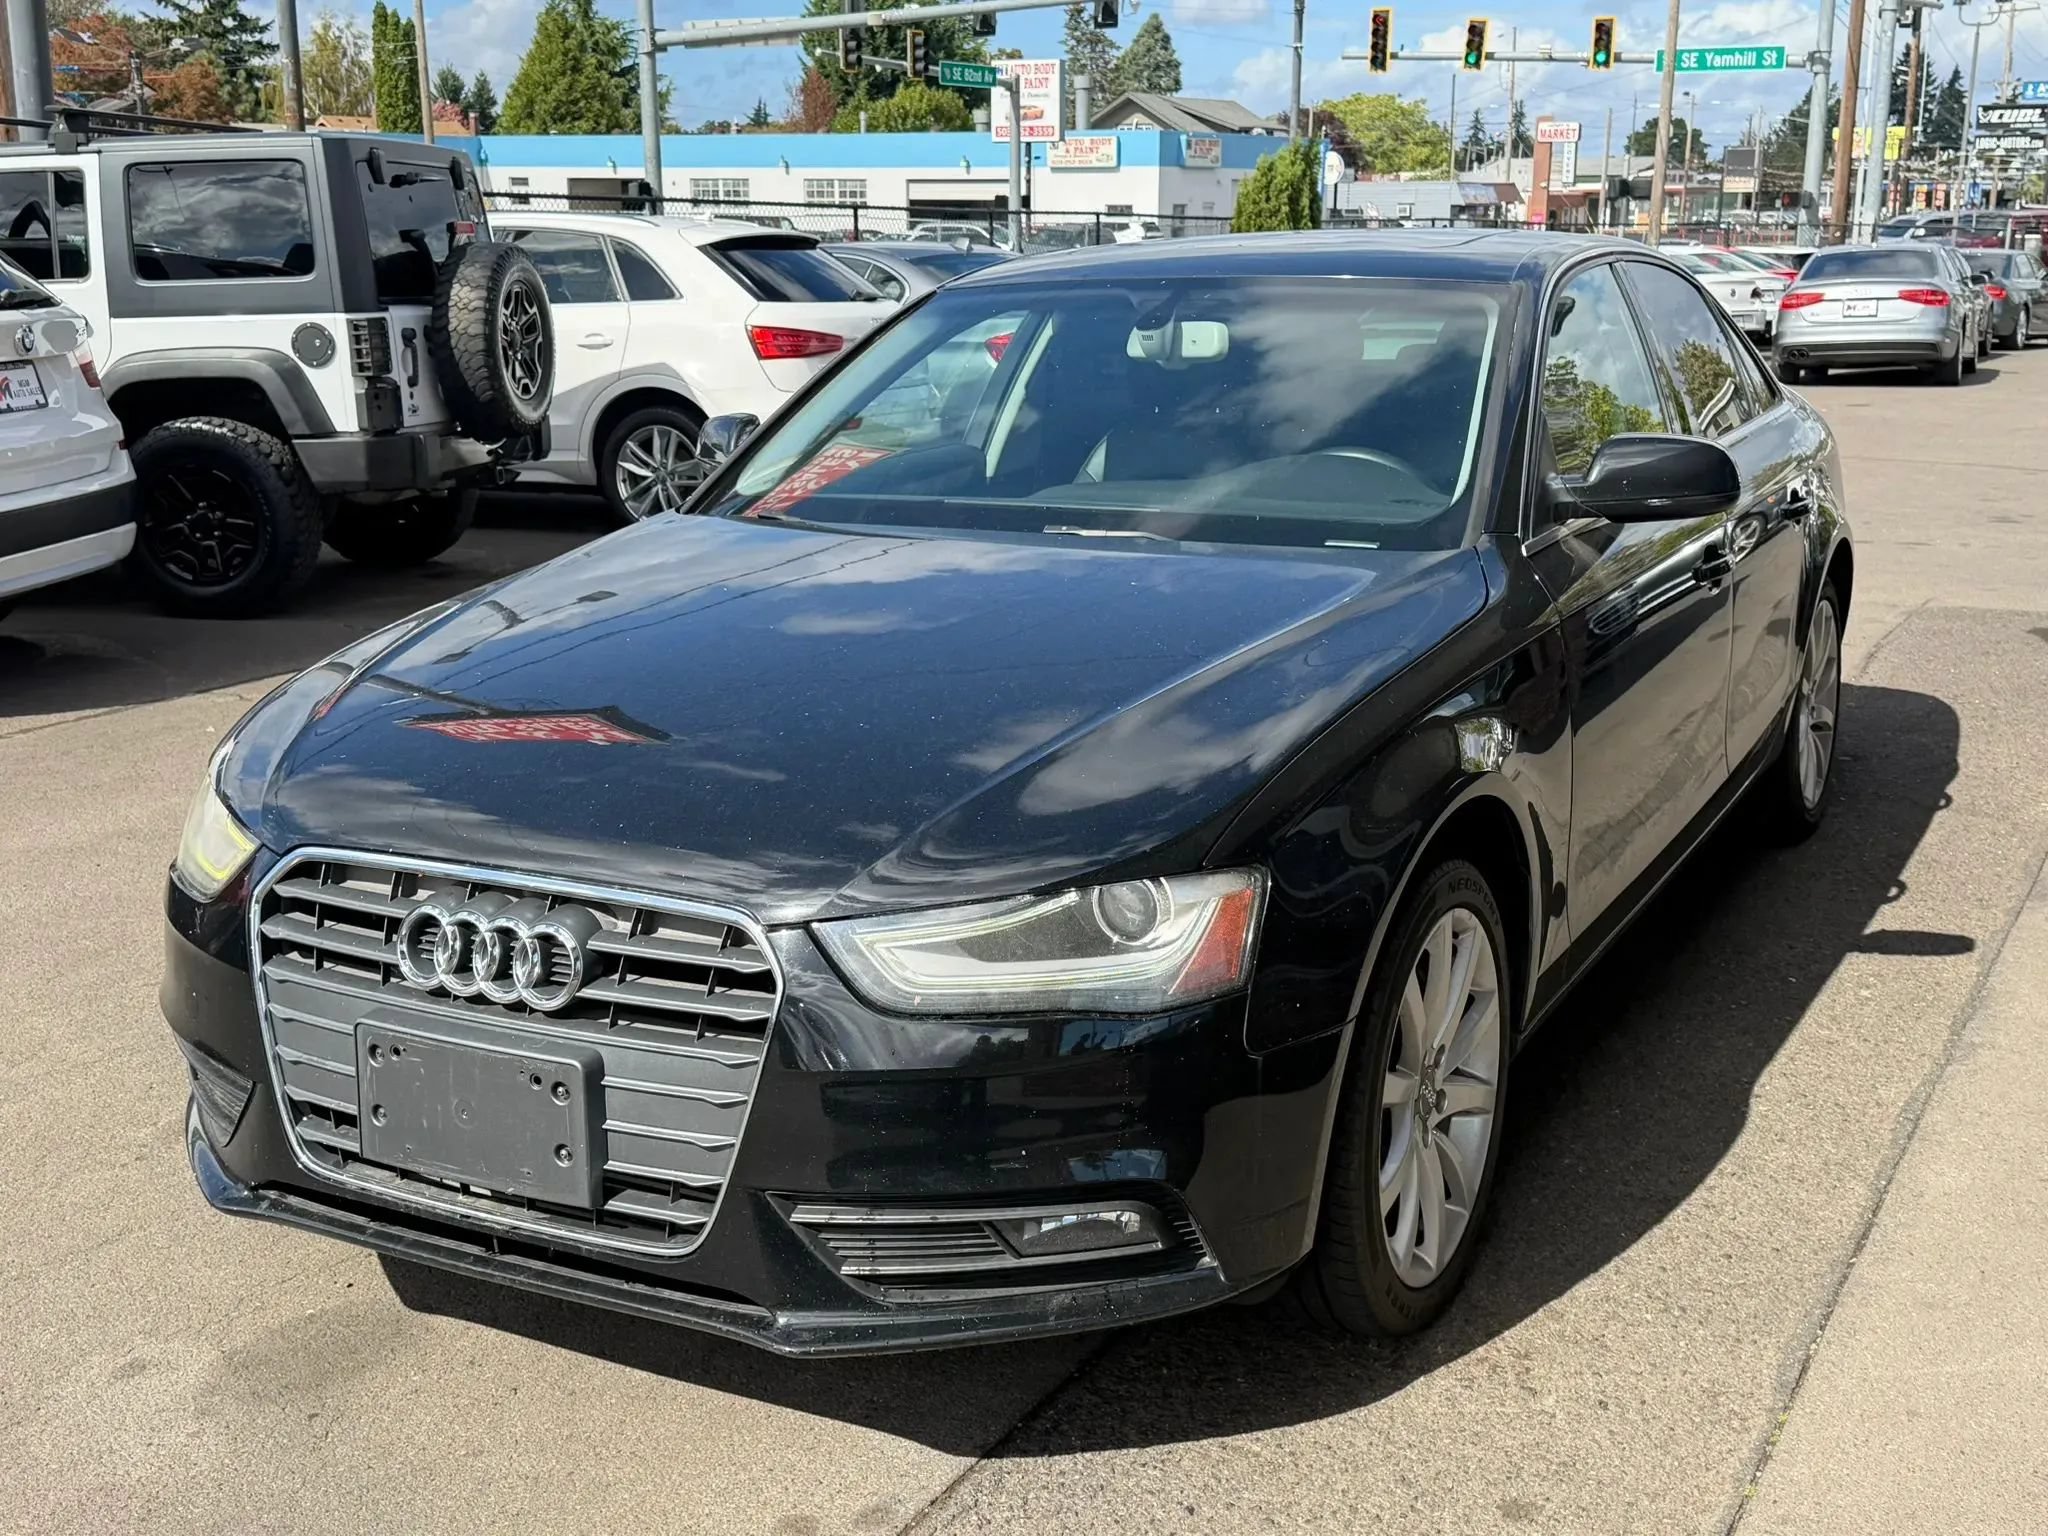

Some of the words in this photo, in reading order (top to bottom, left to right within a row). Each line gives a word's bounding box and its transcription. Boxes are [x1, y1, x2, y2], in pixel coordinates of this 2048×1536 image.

[1681, 52, 1699, 68] SE
[1705, 50, 1757, 68] Yamhill
[1762, 50, 1778, 66] St
[1034, 64, 1056, 74] BODY
[952, 67, 962, 80] SE
[964, 68, 982, 82] 82nd
[984, 70, 994, 83] Av
[1024, 78, 1049, 88] PAINT
[1540, 128, 1576, 139] MARKET
